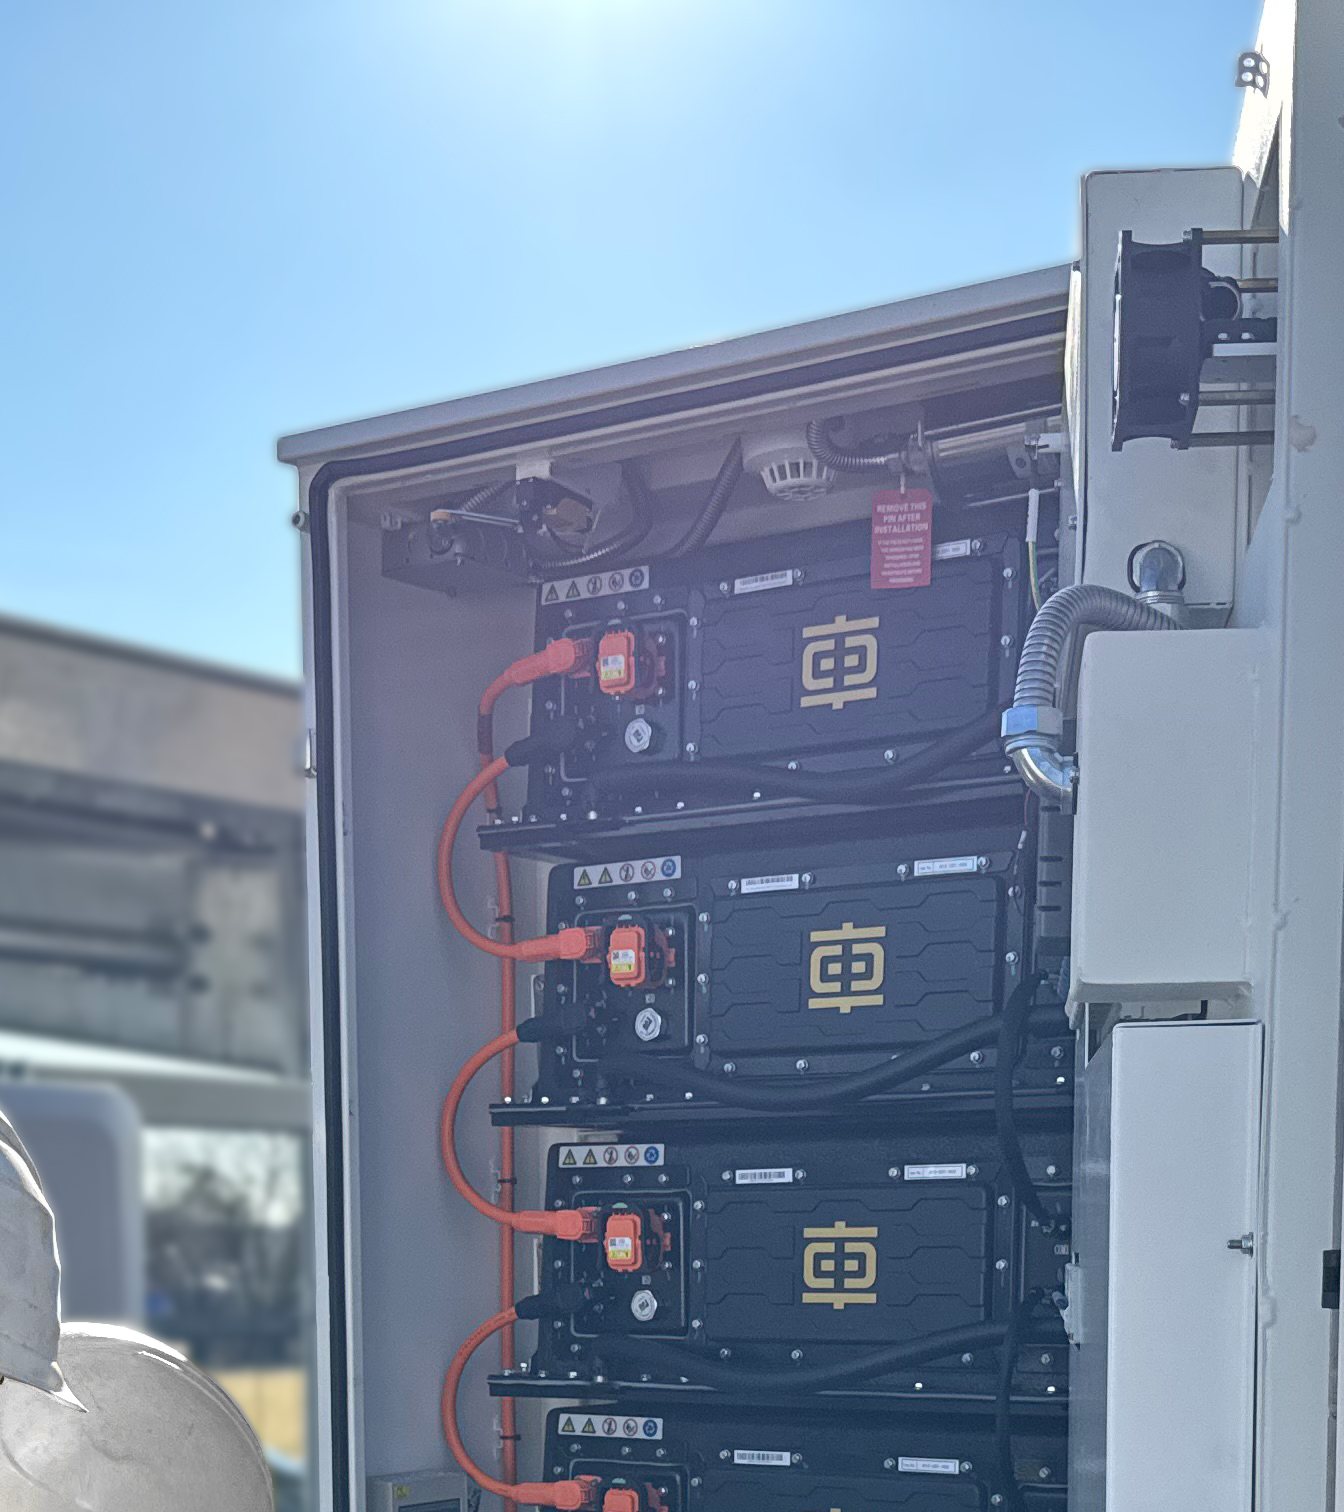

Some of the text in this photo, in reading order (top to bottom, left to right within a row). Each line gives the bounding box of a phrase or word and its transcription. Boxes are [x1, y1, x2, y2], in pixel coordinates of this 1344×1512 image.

[876, 503, 909, 513] REMOVE
[897, 512, 921, 522] AFTER
[874, 522, 929, 534] INSTALLATION
